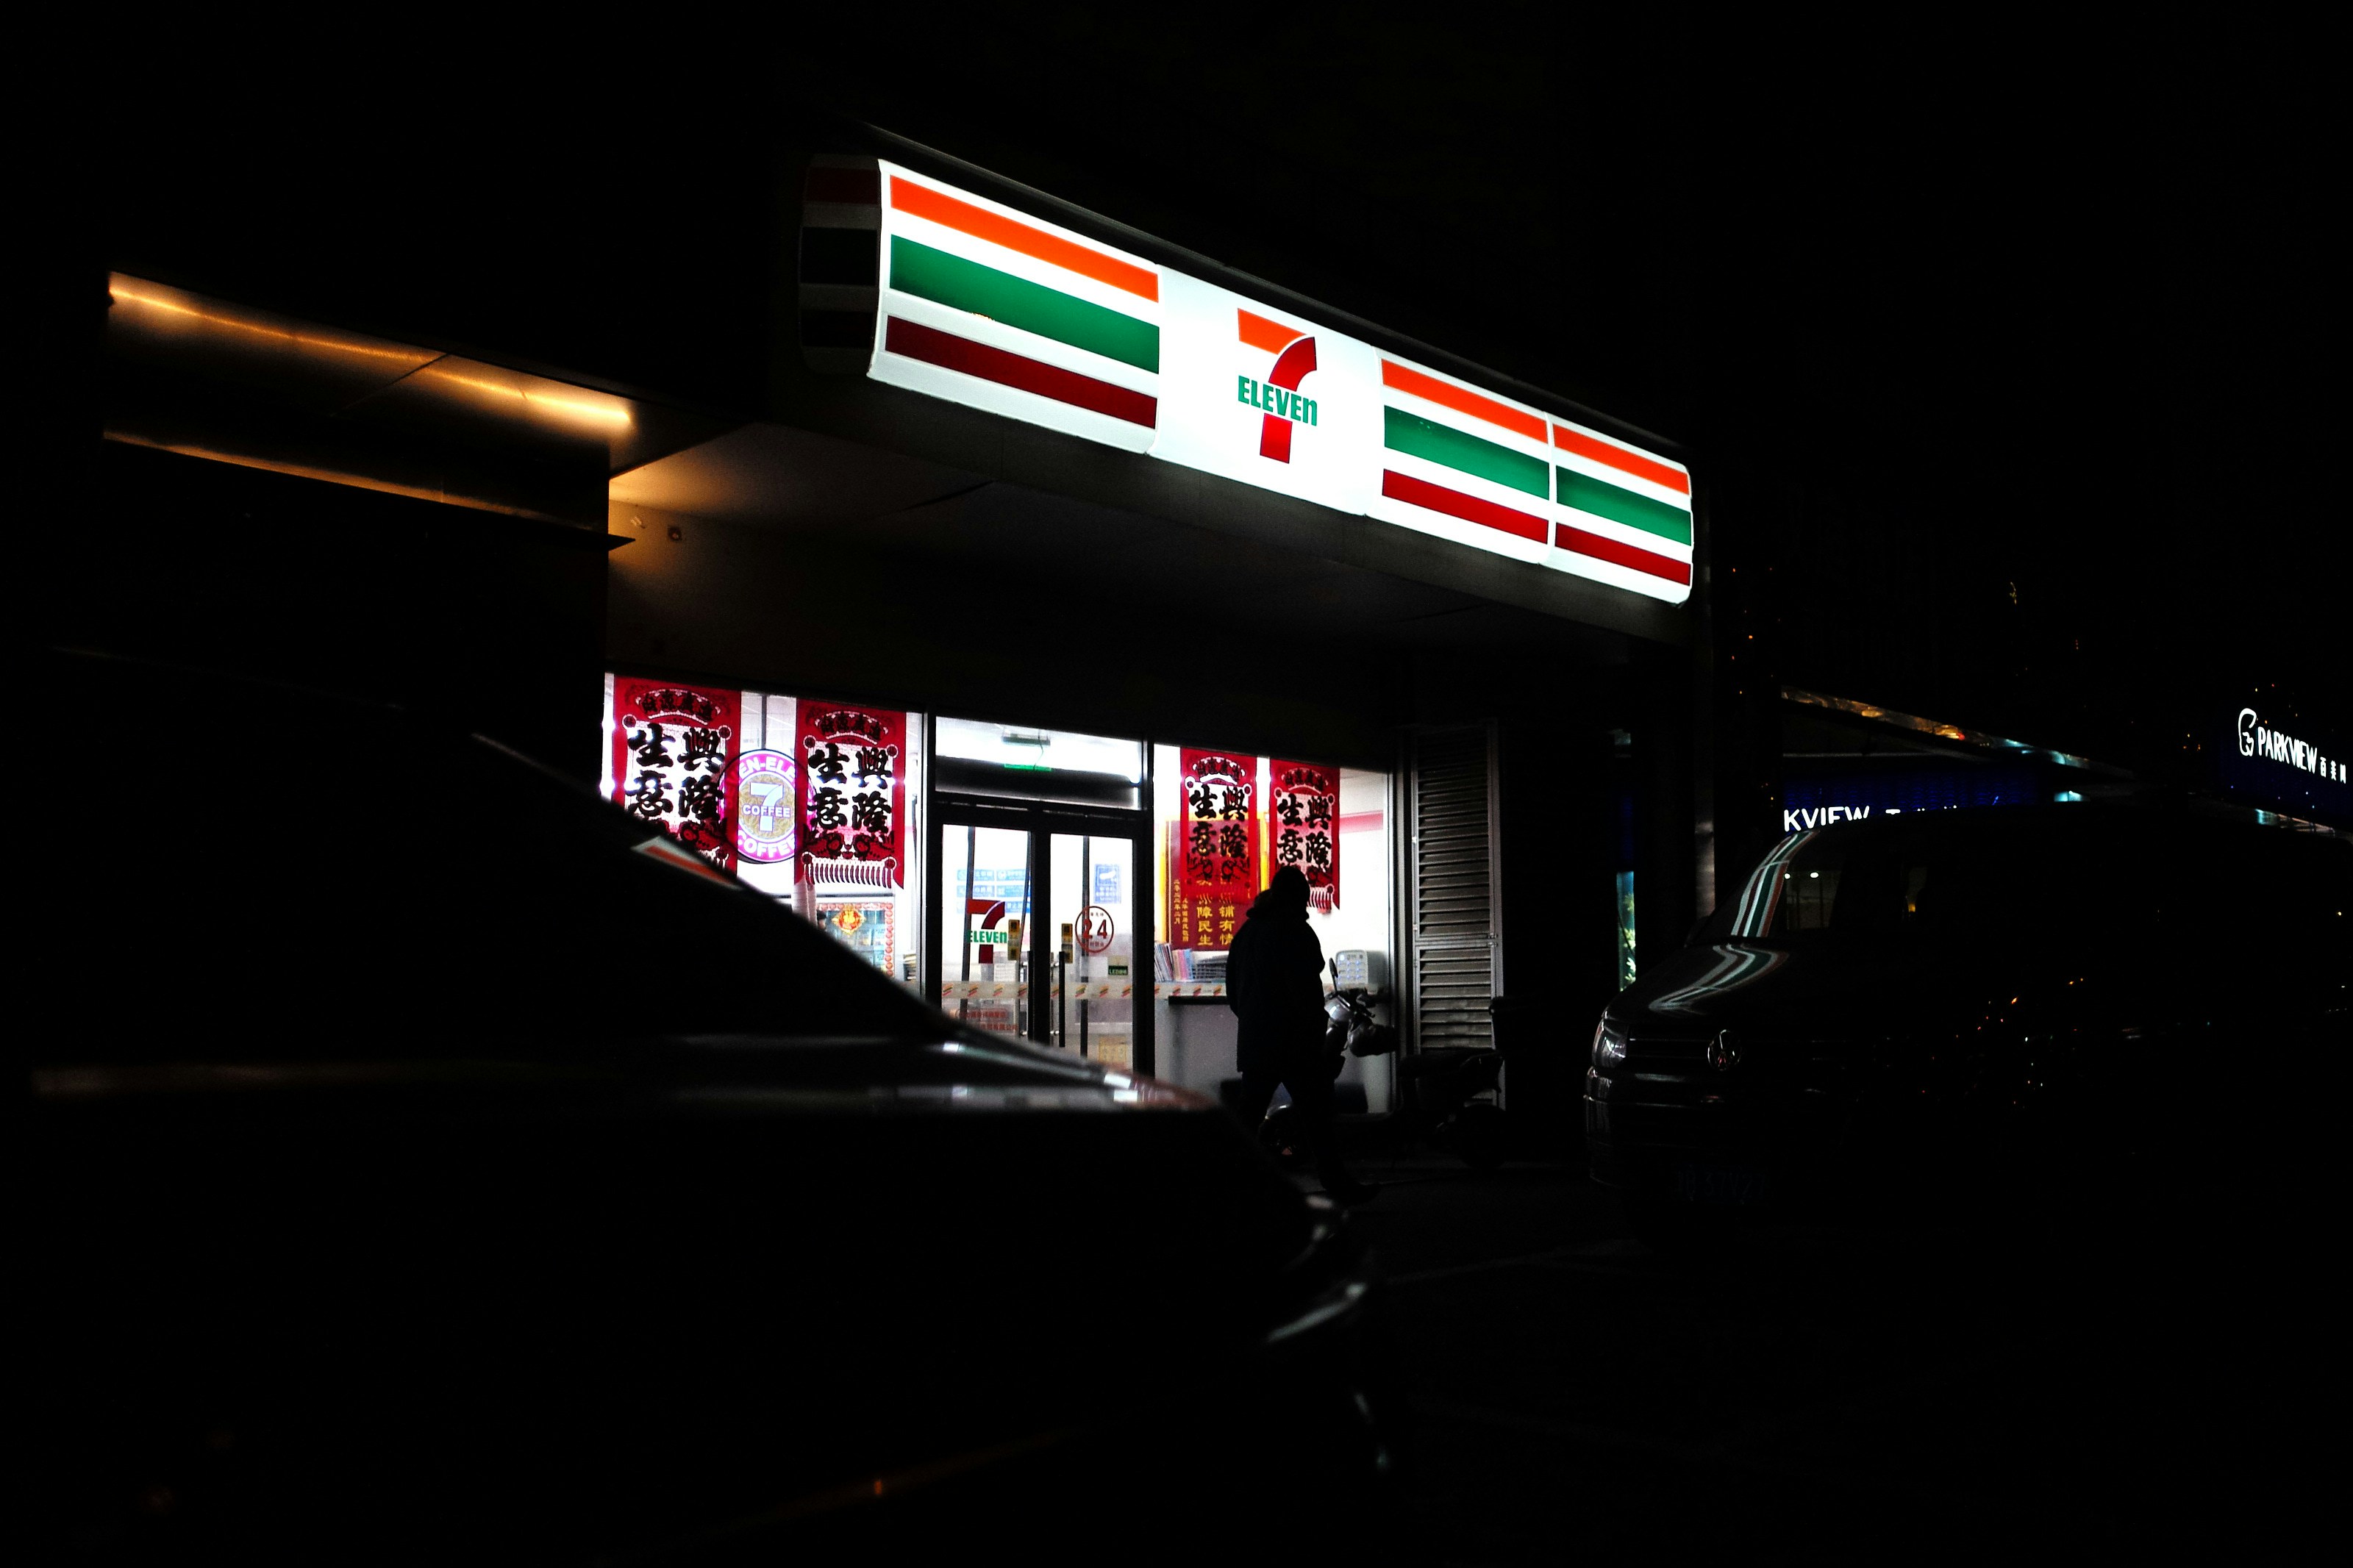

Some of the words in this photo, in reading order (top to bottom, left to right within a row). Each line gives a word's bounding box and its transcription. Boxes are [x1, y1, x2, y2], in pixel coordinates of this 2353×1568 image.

[2257, 726, 2318, 774] PARKVIEW
[743, 804, 790, 818] COFFEE
[1083, 919, 1107, 939] 24
